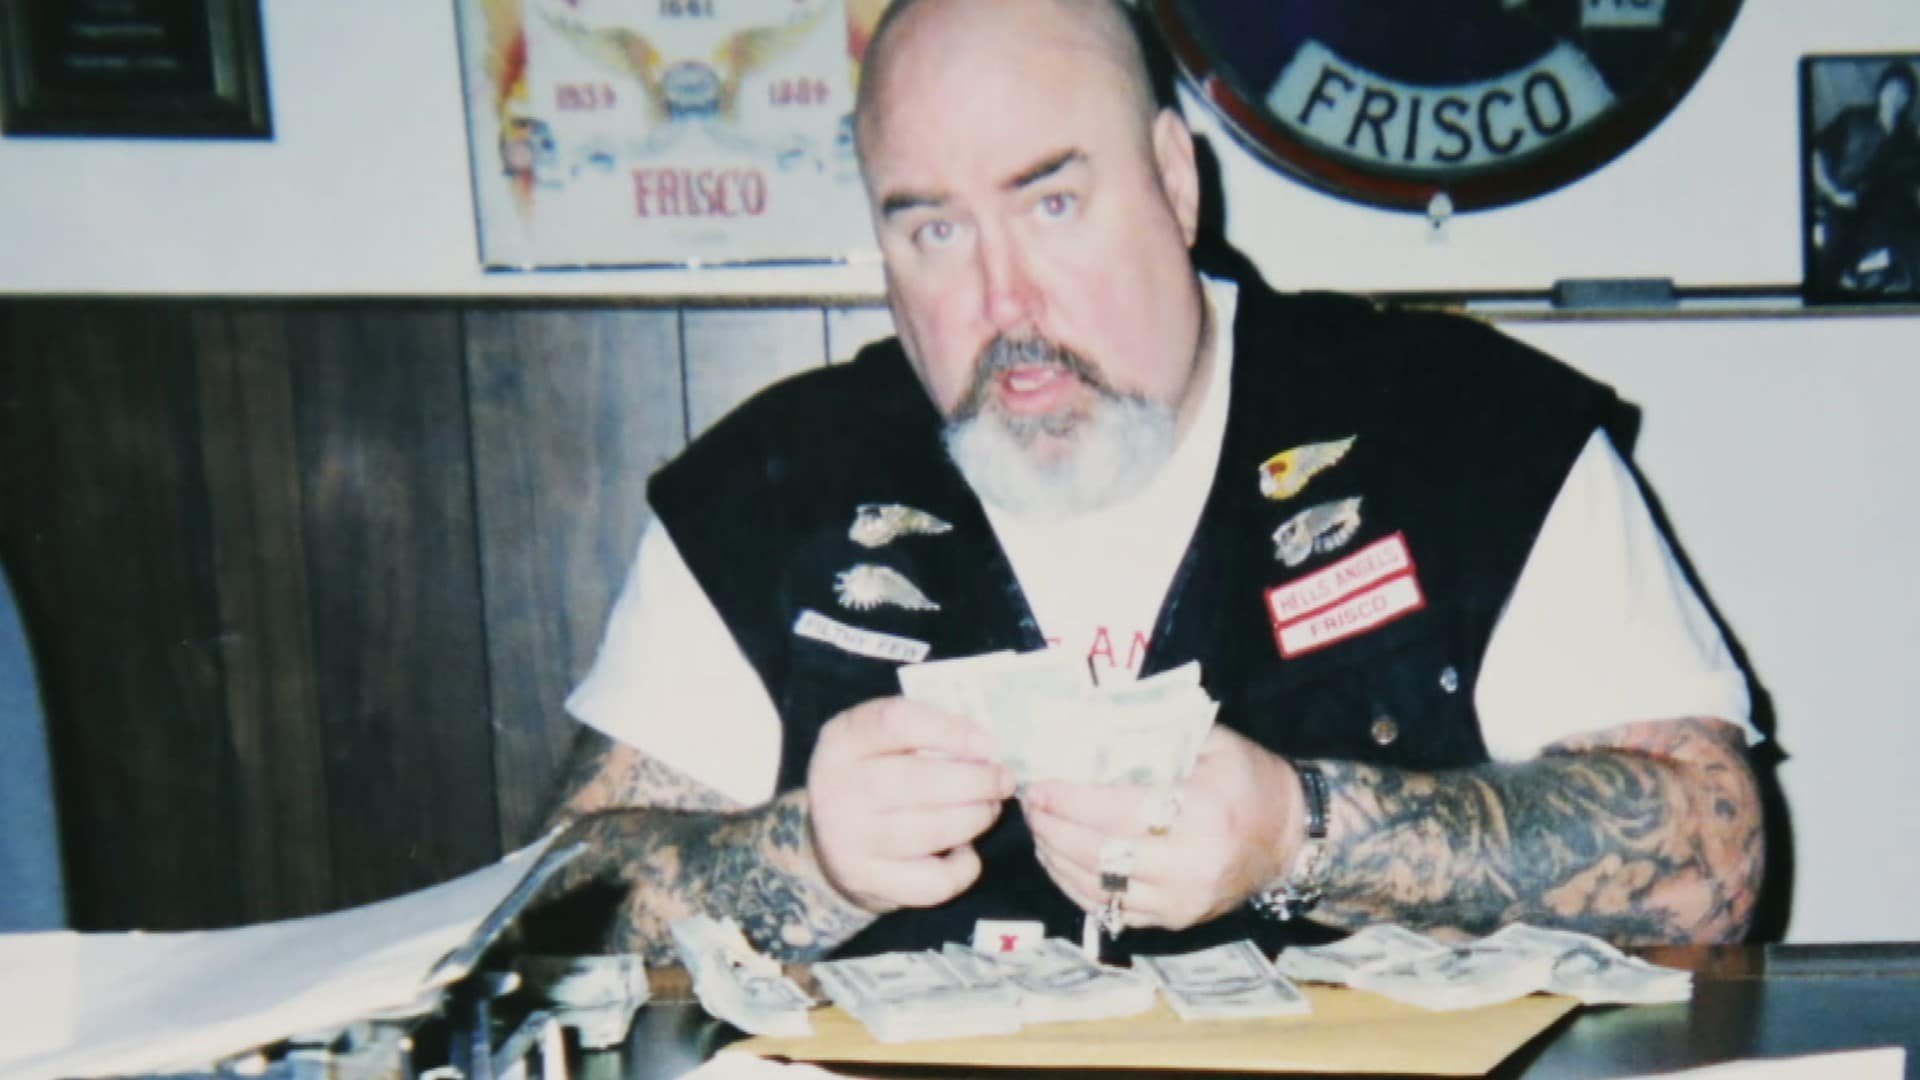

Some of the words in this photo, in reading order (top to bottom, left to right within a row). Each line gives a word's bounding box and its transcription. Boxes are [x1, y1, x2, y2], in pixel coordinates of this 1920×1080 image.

[1297, 63, 1571, 163] FRISCO
[632, 168, 767, 218] FRISCO
[1279, 579, 1331, 614] HELLS
[1335, 545, 1400, 589] ANGELS
[1309, 594, 1388, 638] FRISCO
